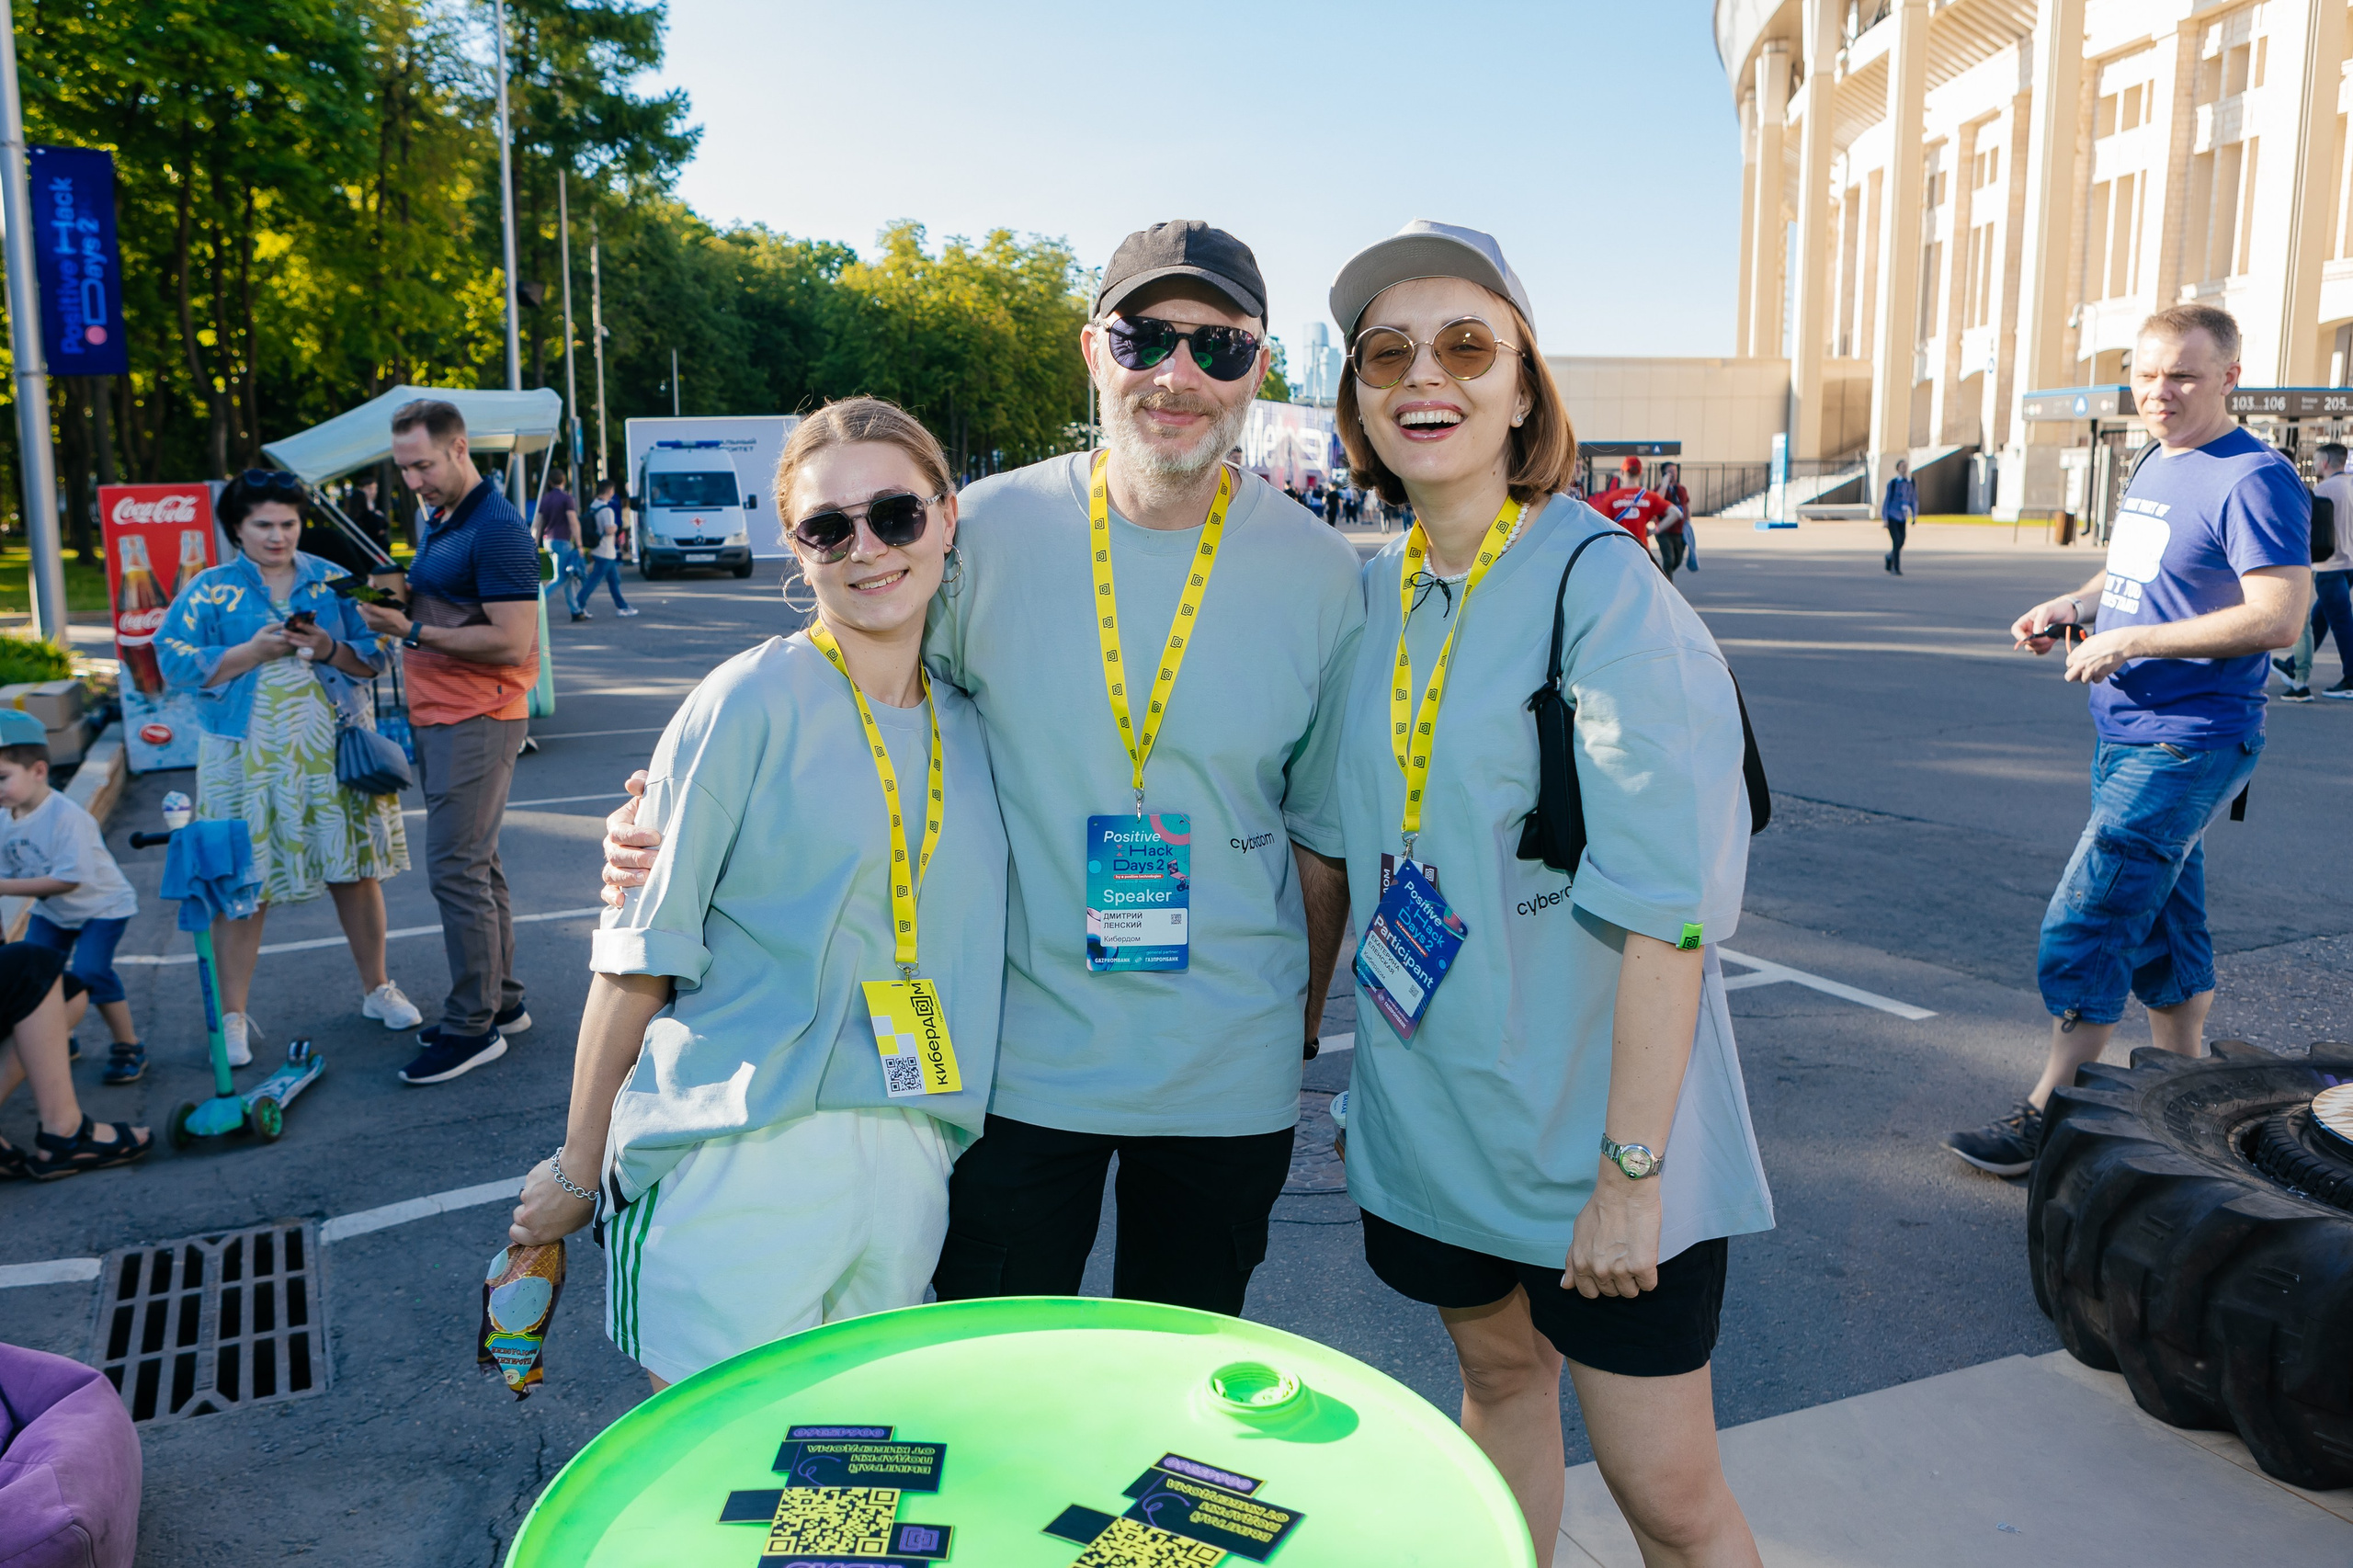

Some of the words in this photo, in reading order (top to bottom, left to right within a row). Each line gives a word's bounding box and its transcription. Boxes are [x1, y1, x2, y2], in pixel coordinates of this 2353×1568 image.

[49, 176, 76, 255] Hack
[81, 237, 108, 325] Days
[56, 259, 85, 354] Positive
[111, 494, 199, 525] Coca-Cola
[1104, 830, 1161, 843] Positive
[1130, 845, 1173, 857] Hack
[1113, 859, 1154, 873] Days
[1156, 859, 1165, 870] 2
[1103, 890, 1173, 905] Speaker
[1404, 881, 1442, 926] Positive
[1517, 881, 1573, 915] cyberd
[1103, 912, 1143, 921] ДМИТРИЙ
[1103, 921, 1142, 929] ЛЕНСКИЙ
[1398, 908, 1426, 943] Days
[1425, 940, 1434, 952] 2
[1414, 909, 1445, 948] Hack
[1104, 936, 1141, 944] Кибердом
[1370, 934, 1400, 971] ЕКАТЕРИНА
[1373, 915, 1434, 988] Participant
[807, 1445, 910, 1455] КИБЕРДОМА
[911, 1447, 936, 1455] ОТ
[850, 1455, 933, 1464] ПОДАРКИ
[848, 1463, 931, 1474] ВЫИГРАЙ
